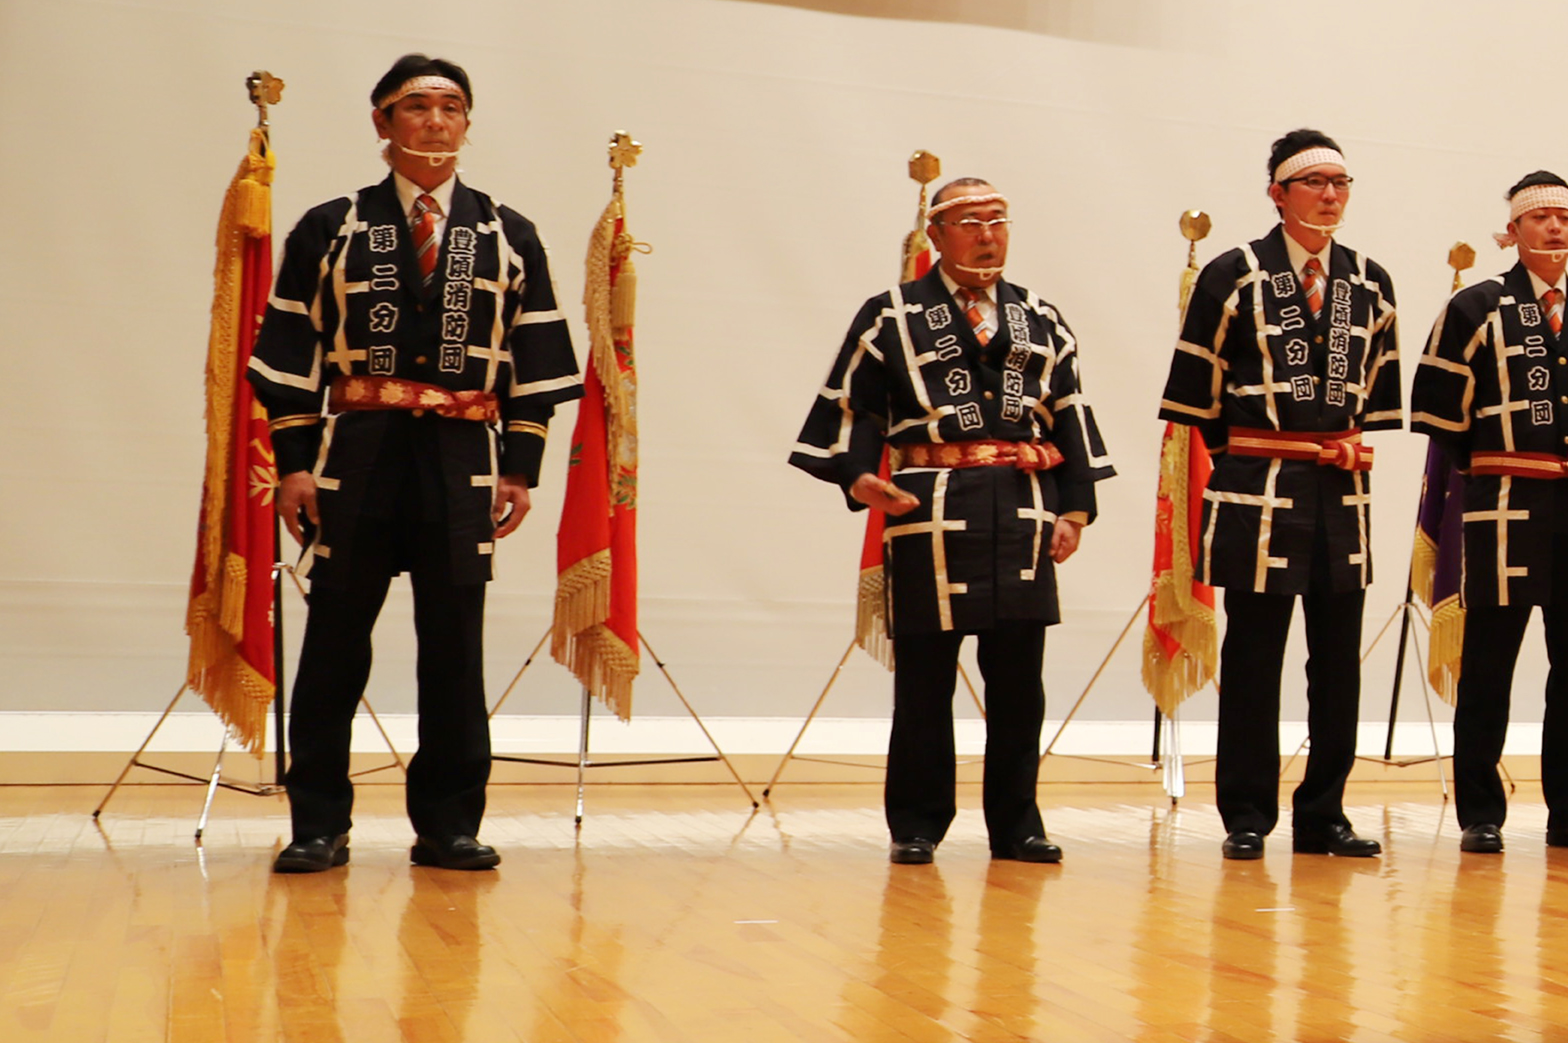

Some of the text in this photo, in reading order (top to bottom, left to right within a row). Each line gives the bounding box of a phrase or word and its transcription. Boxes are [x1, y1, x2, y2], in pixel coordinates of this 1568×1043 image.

[369, 225, 399, 375] 第二分団
[439, 227, 477, 374] 豊頃消防団
[1272, 271, 1315, 401] 第二分団
[1326, 279, 1353, 406] 豊頃消防団
[1519, 303, 1553, 425] 第二分団
[925, 303, 984, 431] 第二分団
